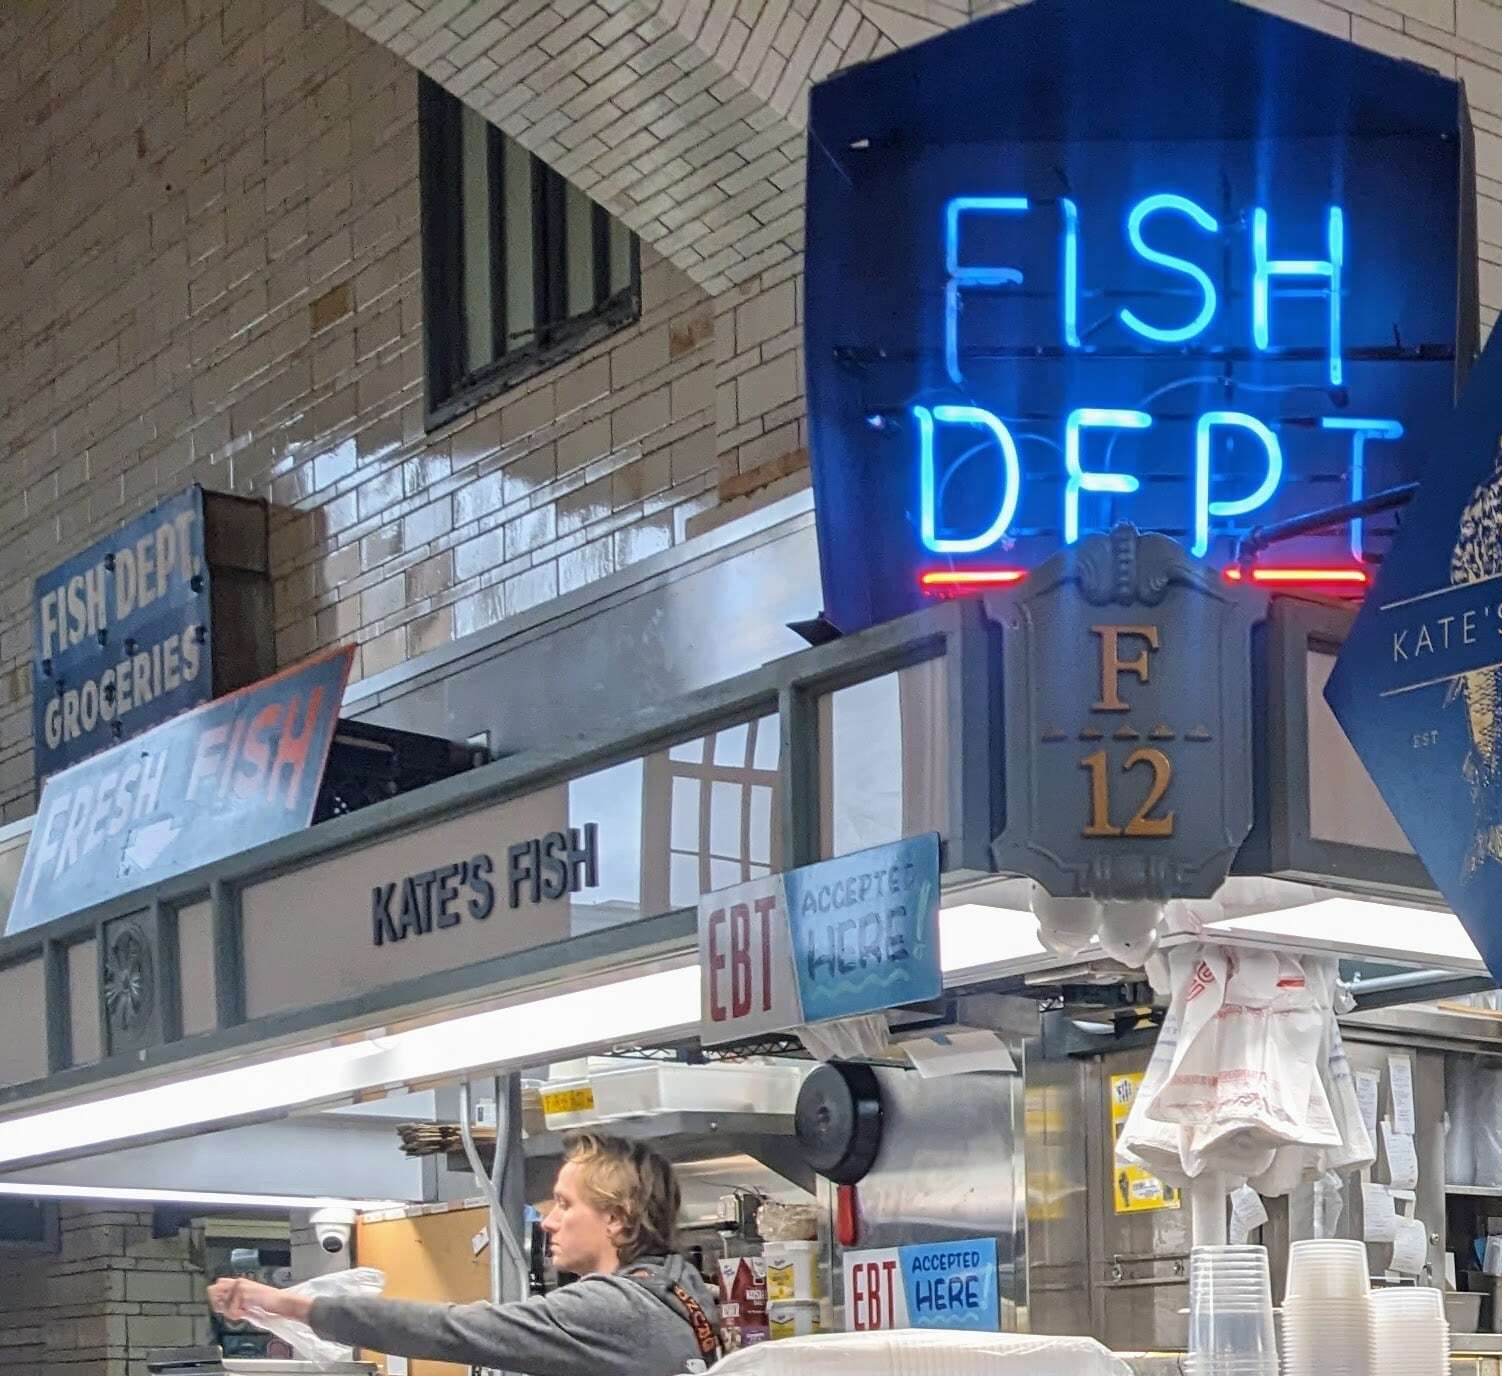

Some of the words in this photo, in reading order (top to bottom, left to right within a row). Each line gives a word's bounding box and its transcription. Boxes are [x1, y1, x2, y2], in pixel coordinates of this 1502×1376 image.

[946, 194, 1343, 385] FISH
[40, 566, 107, 658] FISH
[45, 624, 202, 750] GROCERIES
[1091, 624, 1160, 714] F
[1412, 730, 1439, 749] EST
[24, 750, 168, 908] FRESH
[187, 685, 325, 810] FISH
[1080, 747, 1174, 838] 12
[372, 853, 494, 946] KATE'S
[508, 822, 600, 909] FISH
[709, 895, 776, 1023] EBT
[852, 1260, 897, 1331] EBT
[912, 1251, 980, 1274] ACCEPTED
